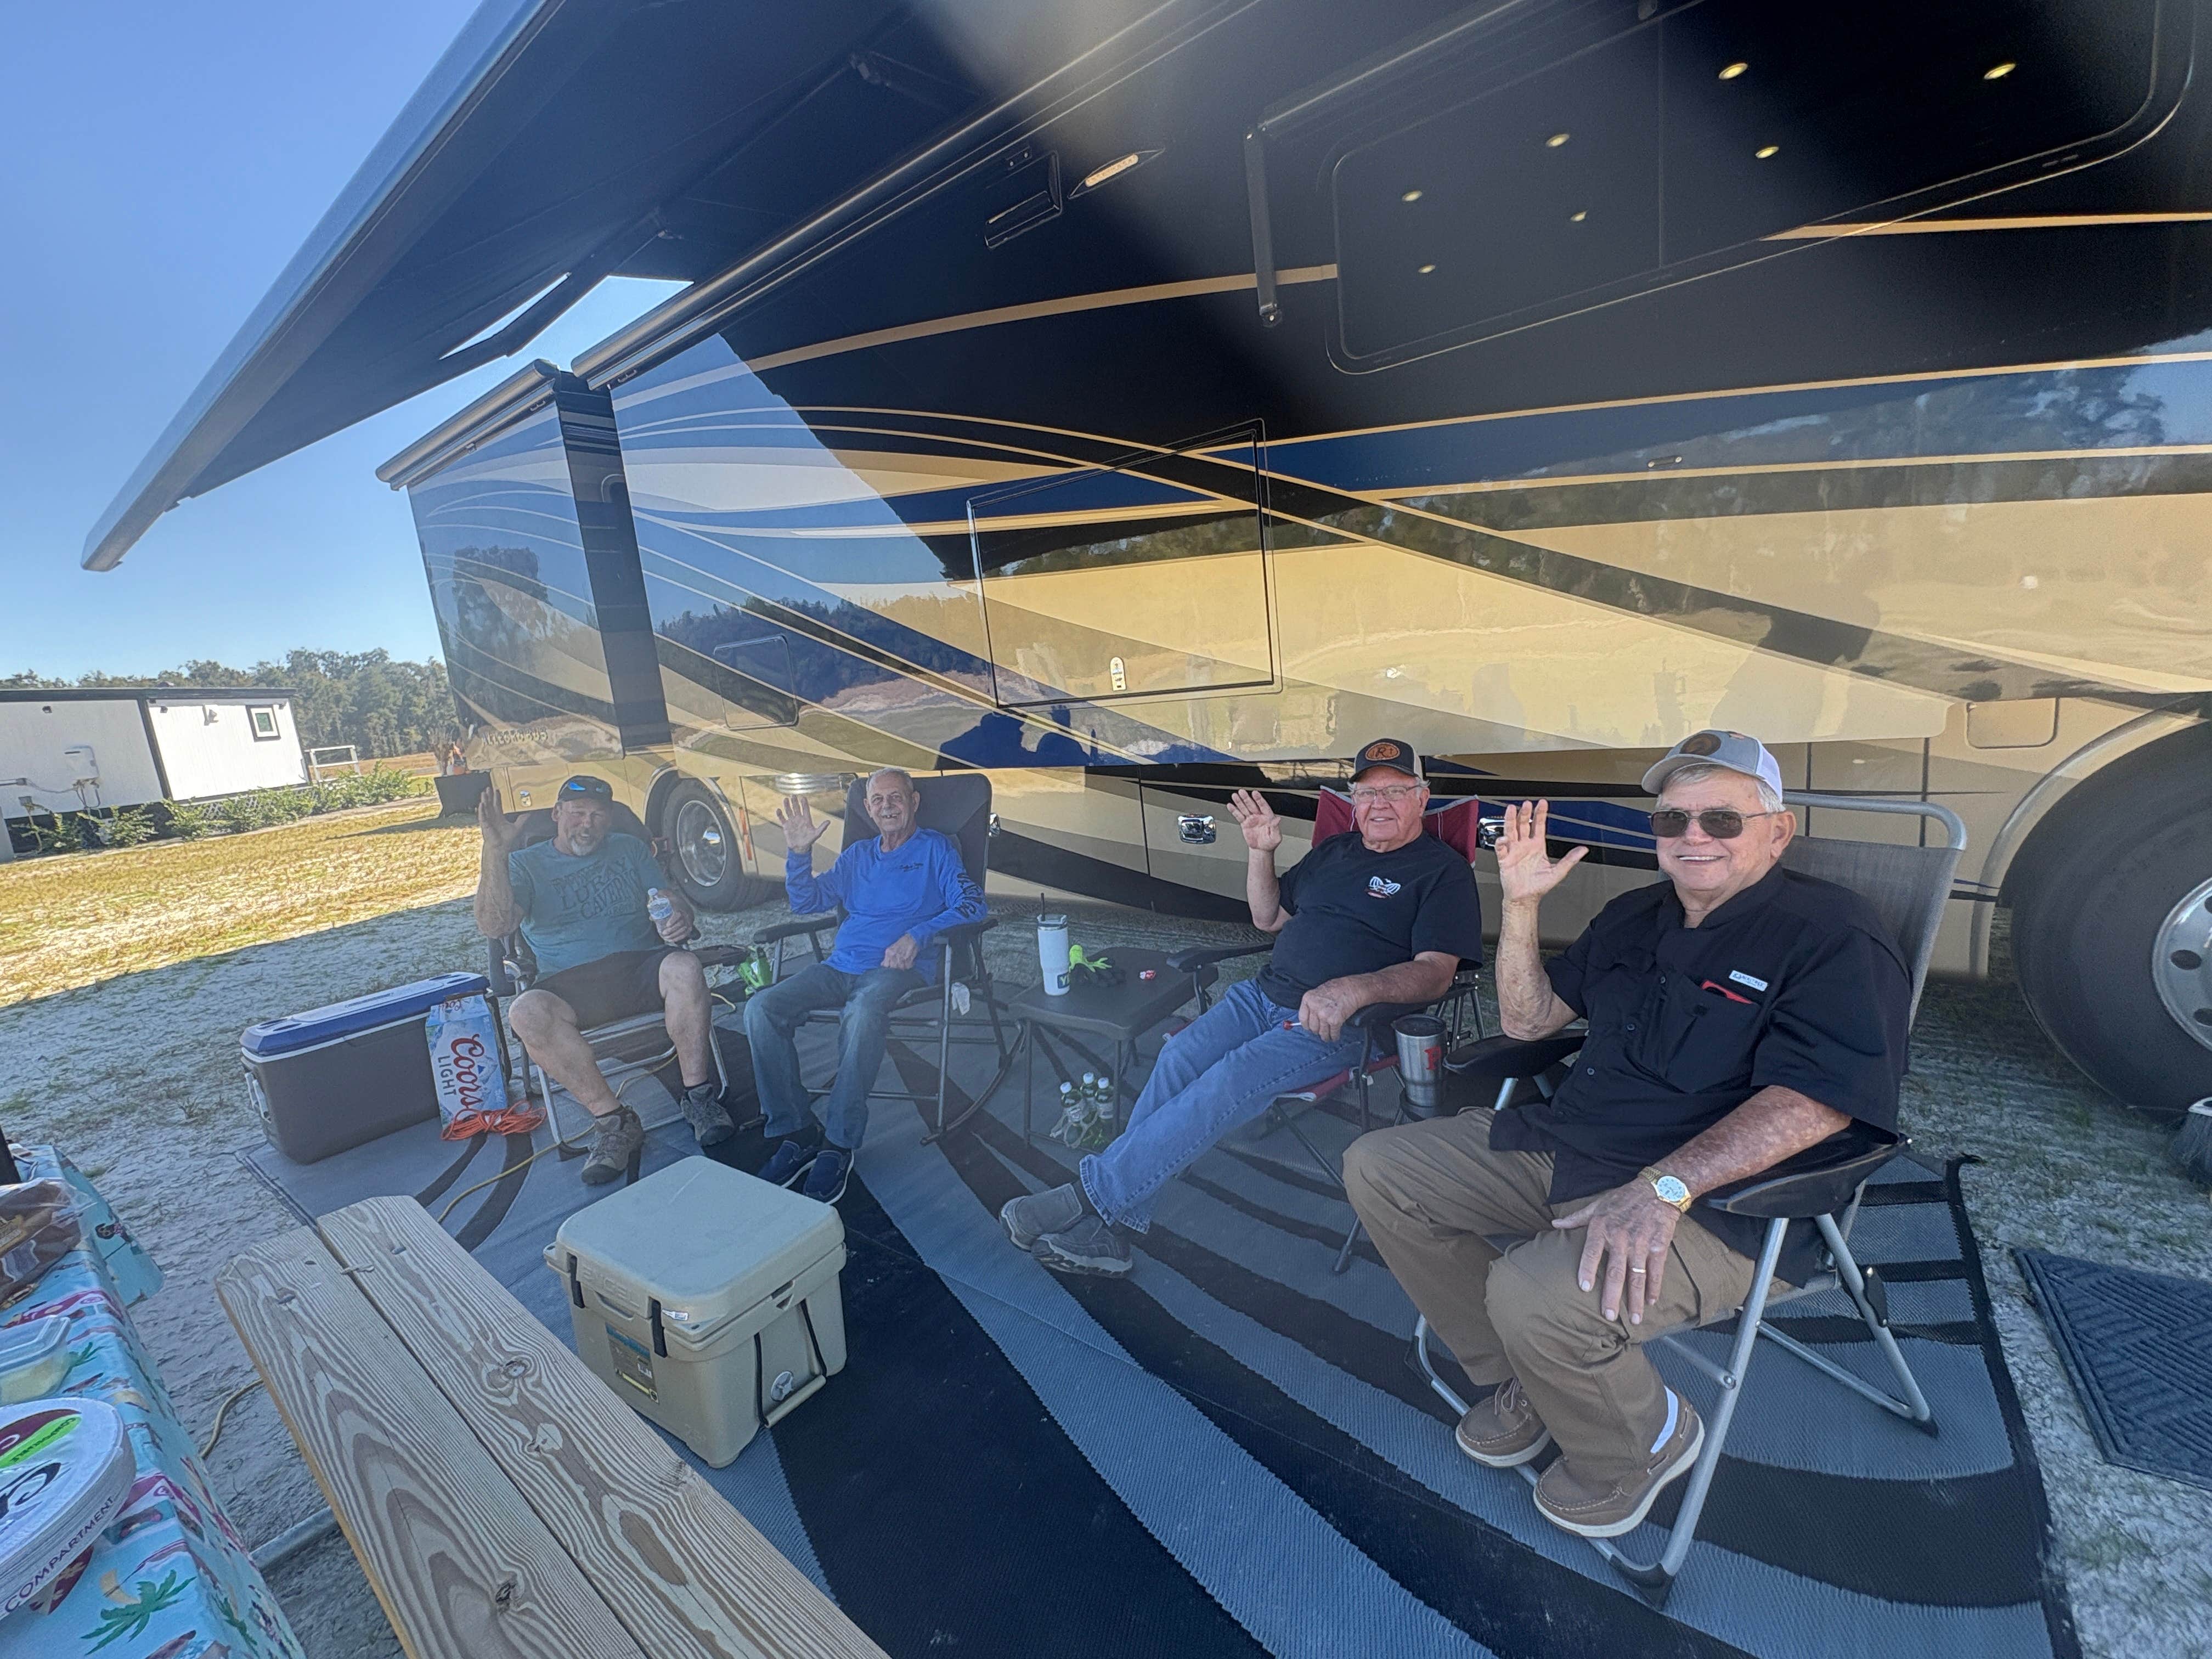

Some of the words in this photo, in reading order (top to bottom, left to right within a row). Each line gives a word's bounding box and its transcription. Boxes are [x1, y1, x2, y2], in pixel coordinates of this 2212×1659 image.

[438, 1055, 456, 1096] LIGHT
[450, 1034, 485, 1110] Coors
[4, 1496, 114, 1612] COMPARTMENT
